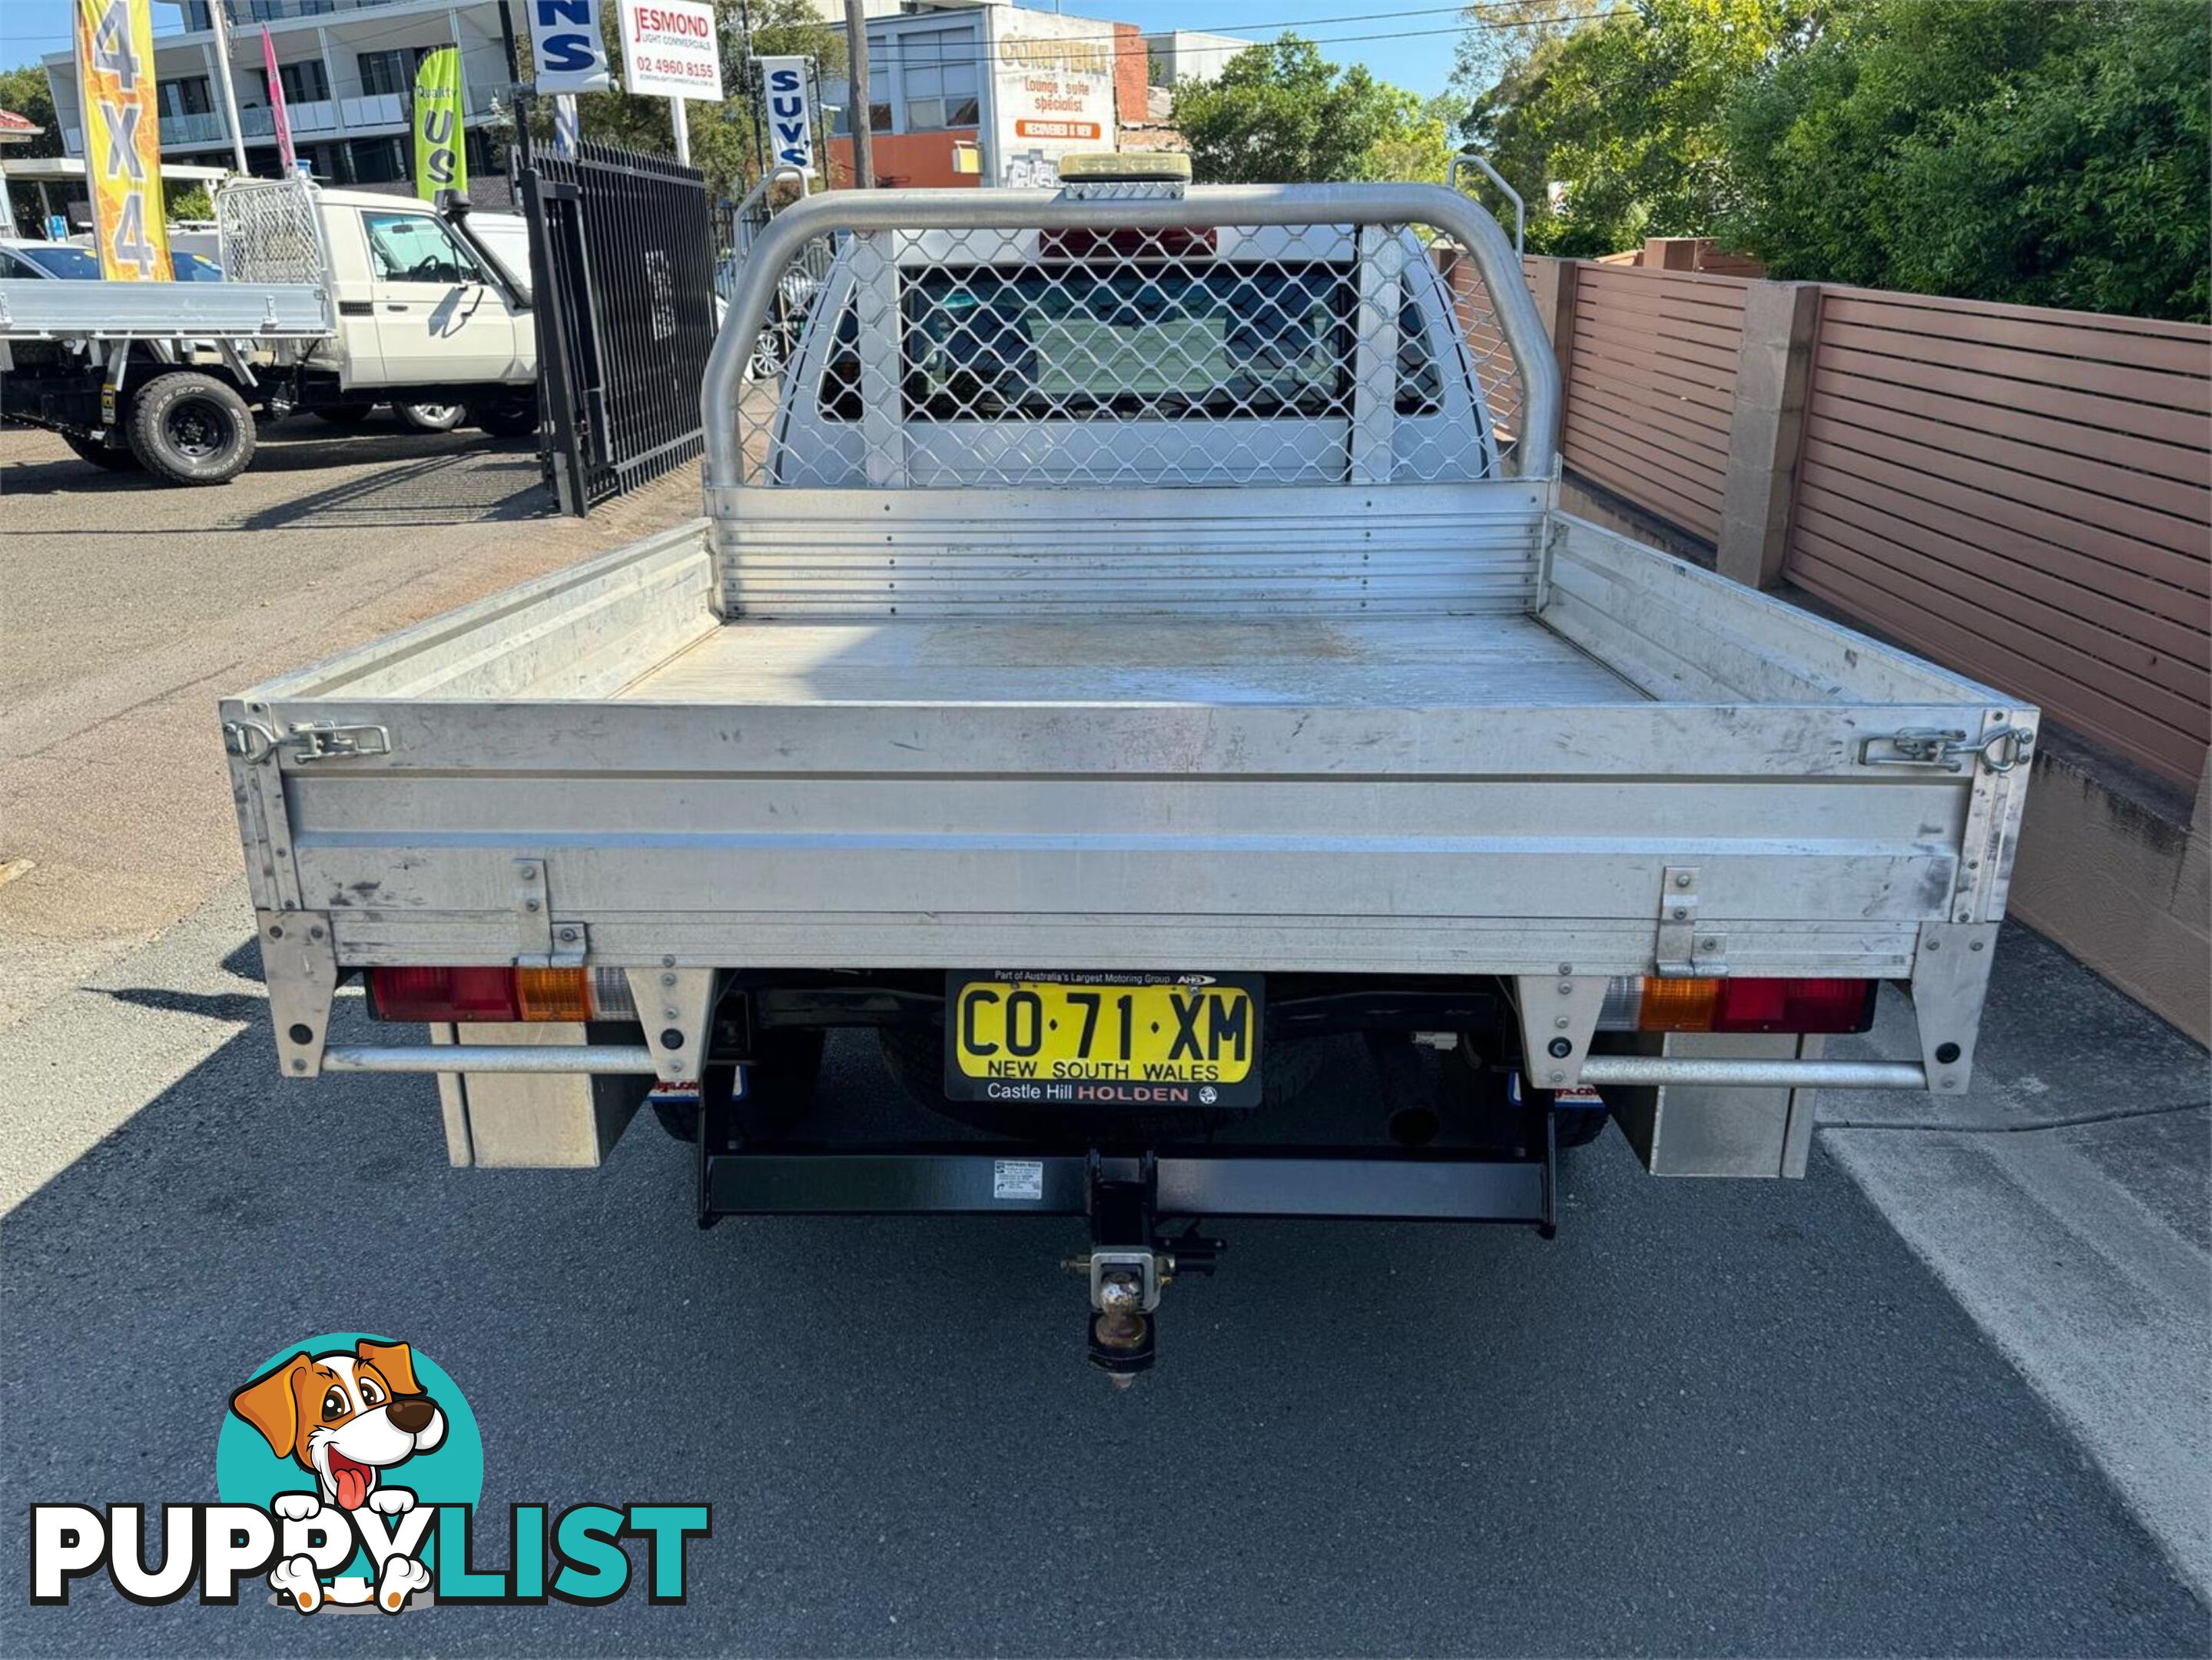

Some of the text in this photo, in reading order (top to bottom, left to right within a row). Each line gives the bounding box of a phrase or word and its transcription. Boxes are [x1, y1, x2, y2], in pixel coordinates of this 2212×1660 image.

[634, 7, 708, 42] JESMOND
[642, 32, 711, 51] LIGHT COMMERCIALS
[636, 56, 714, 78] 02 4960 8155
[417, 85, 457, 100] Quality
[1025, 78, 1089, 97] Lounge suite
[1035, 96, 1083, 114] specialist
[995, 971, 1012, 980] Part
[1014, 971, 1023, 980] of
[1024, 971, 1069, 981] Australia's
[1071, 974, 1103, 983] Largest
[1105, 974, 1142, 984] Motoring
[1145, 974, 1171, 984] Group
[988, 1060, 1219, 1081] NEW SOUTH WALES
[987, 1083, 1189, 1102] Castle Hill HOLDEN
